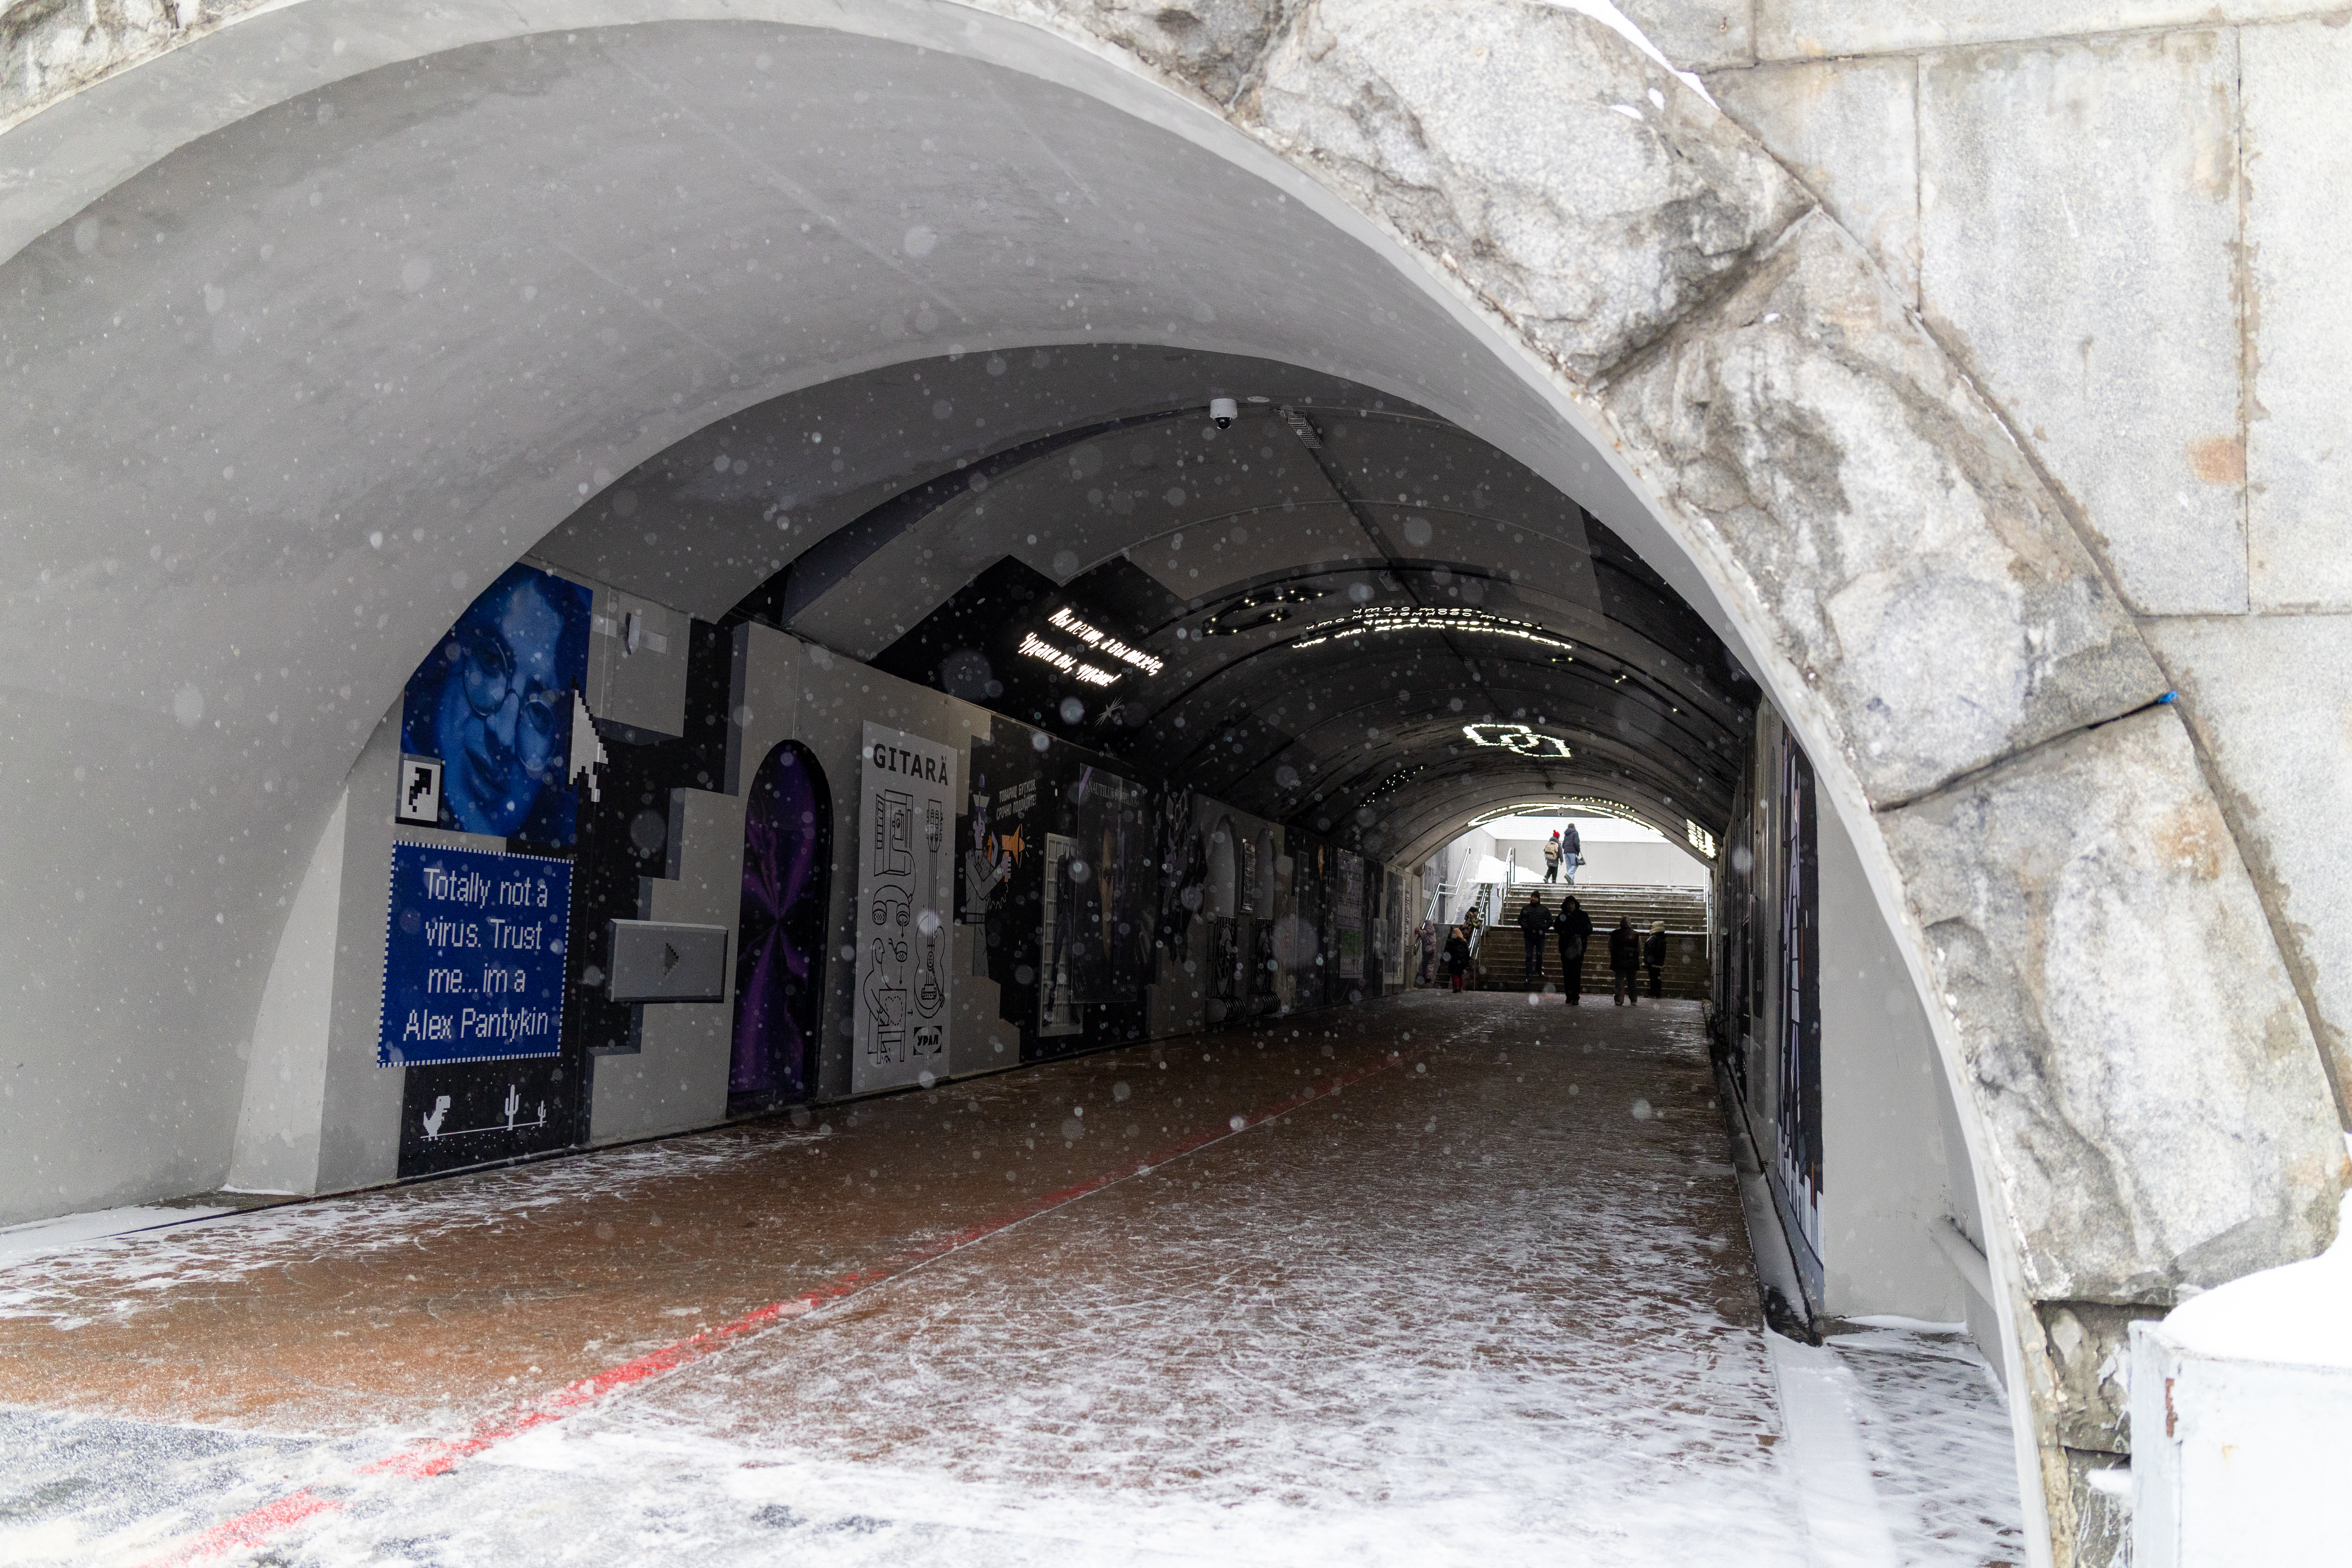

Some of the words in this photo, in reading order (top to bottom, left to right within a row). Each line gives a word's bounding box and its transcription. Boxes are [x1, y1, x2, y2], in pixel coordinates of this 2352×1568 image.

[1048, 608, 1075, 628] Мы
[1100, 639, 1116, 650] а
[1107, 642, 1131, 658] вы
[1018, 632, 1062, 662] Чудаки
[1053, 654, 1077, 674] вы,
[1076, 664, 1122, 687] чудаки!
[999, 785, 1017, 804] ТОВАРИЩ
[1086, 780, 1114, 800] NAUTILUS
[996, 803, 1012, 820] СРОЧНО
[423, 867, 491, 909] Totally
[499, 877, 531, 906] not
[537, 885, 548, 907] a
[425, 915, 481, 947] virus.
[490, 918, 543, 950] Trust
[514, 969, 526, 993] a
[403, 1009, 453, 1041] Alex
[460, 1006, 548, 1042] Pantykin
[917, 1034, 939, 1047] УРАЛ
